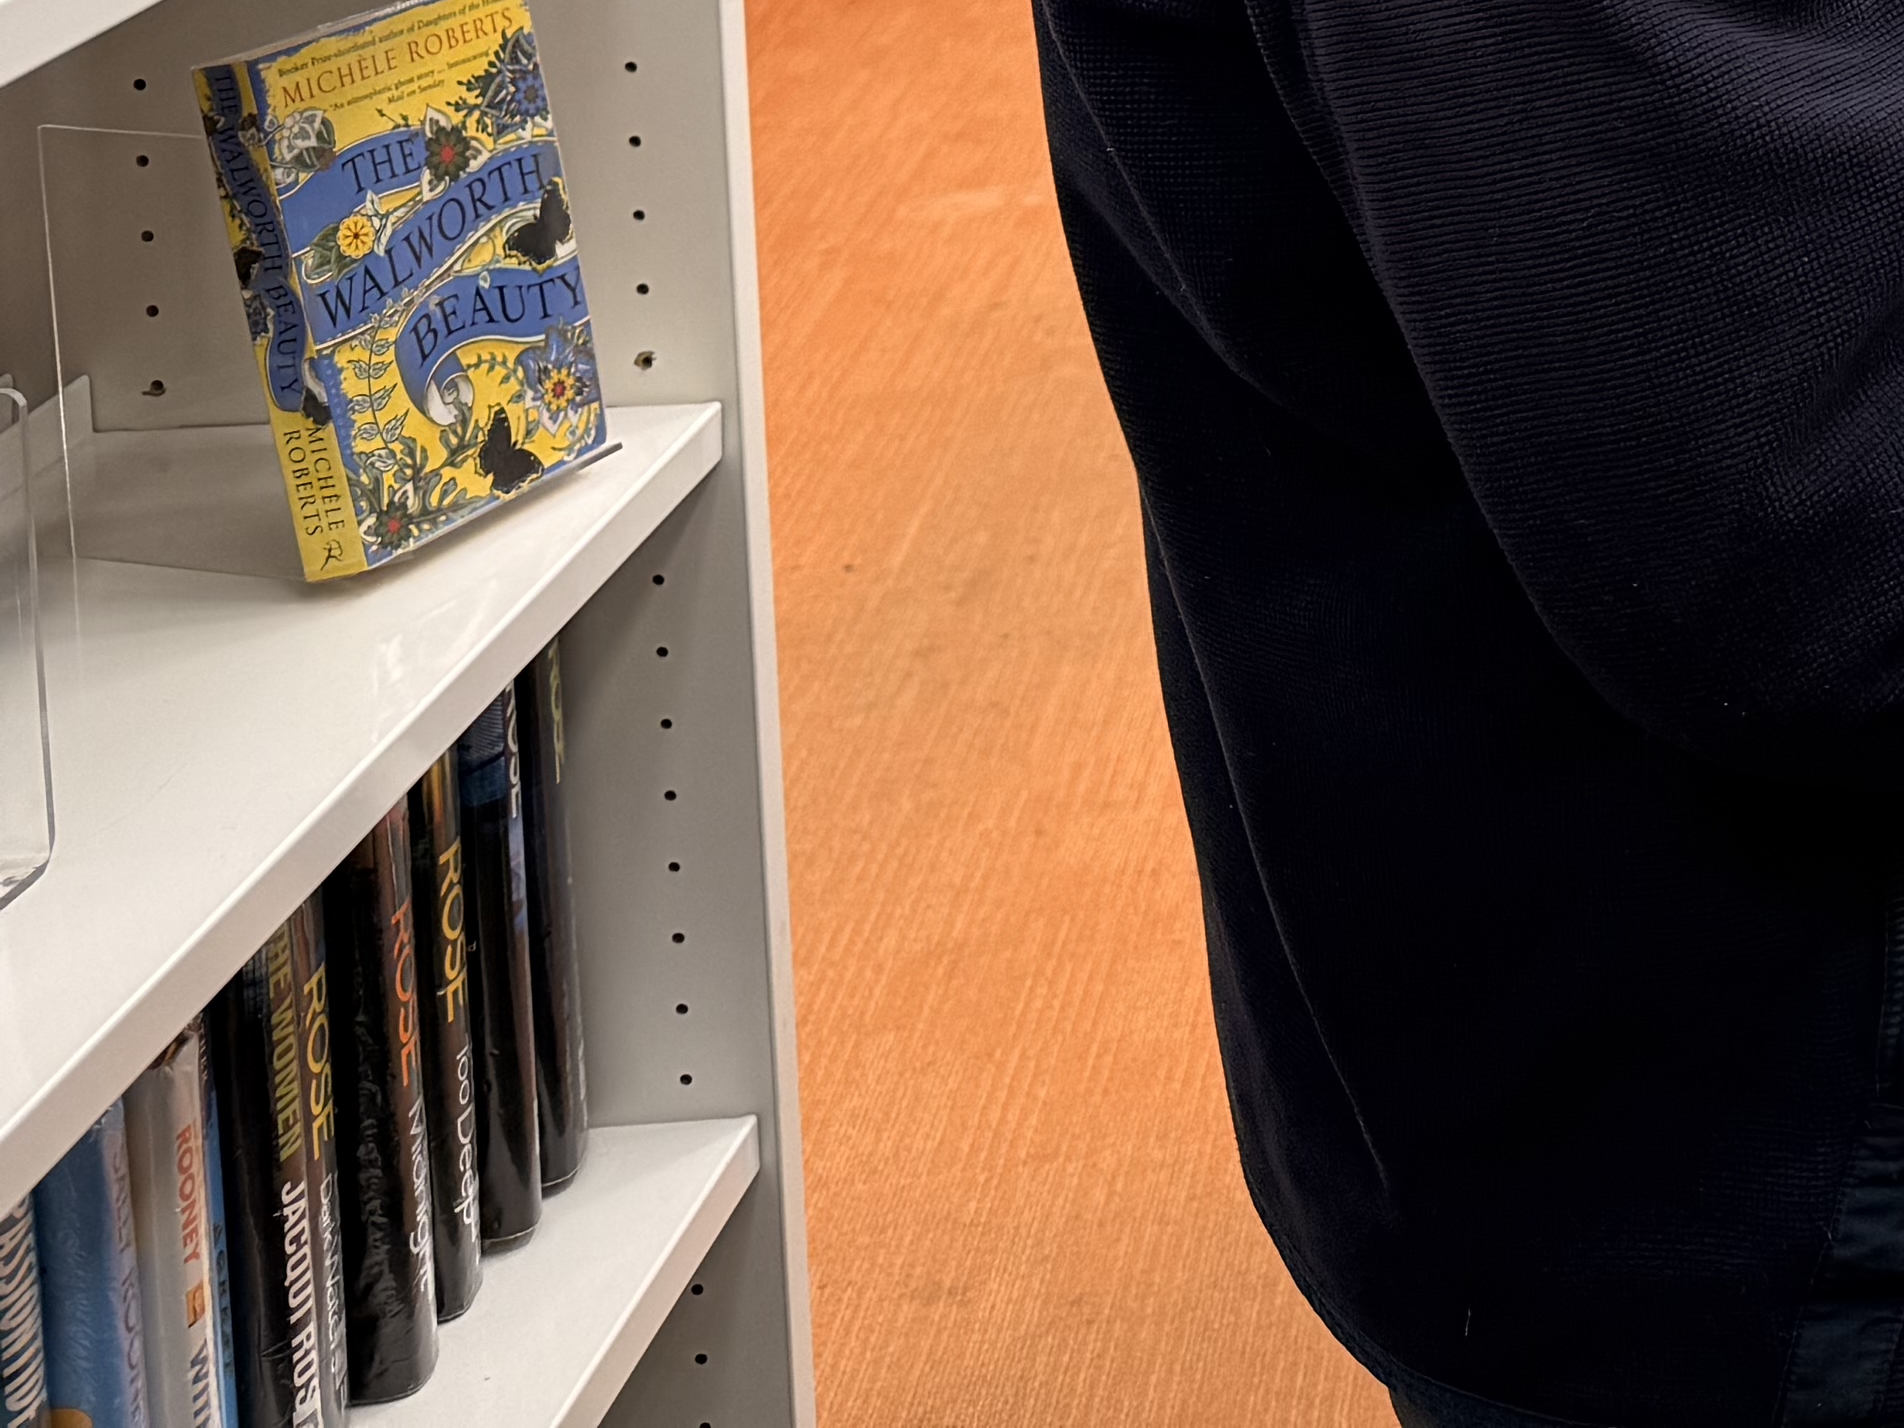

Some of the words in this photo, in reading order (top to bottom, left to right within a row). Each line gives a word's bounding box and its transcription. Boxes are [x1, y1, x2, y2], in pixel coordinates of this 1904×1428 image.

[211, 75, 235, 114] THE
[282, 46, 398, 110] MICHÈLE
[406, 8, 515, 63] ROBERTS
[220, 118, 281, 275] WALWORTH
[339, 135, 424, 195] THE
[317, 151, 546, 331] WALWORTH
[266, 284, 301, 396] BEAUTY
[408, 265, 584, 367] BEAUTY
[283, 430, 324, 536] ROBERTS
[305, 425, 346, 532] MICHÈLE
[391, 900, 418, 1088] ROSE
[438, 839, 470, 1024] ROSE
[271, 1009, 304, 1161] WOMEN
[304, 962, 334, 1159] ROSE
[173, 1124, 202, 1269] ROONEY
[454, 1111, 479, 1244] Deep
[281, 1180, 316, 1322] JACQUI
